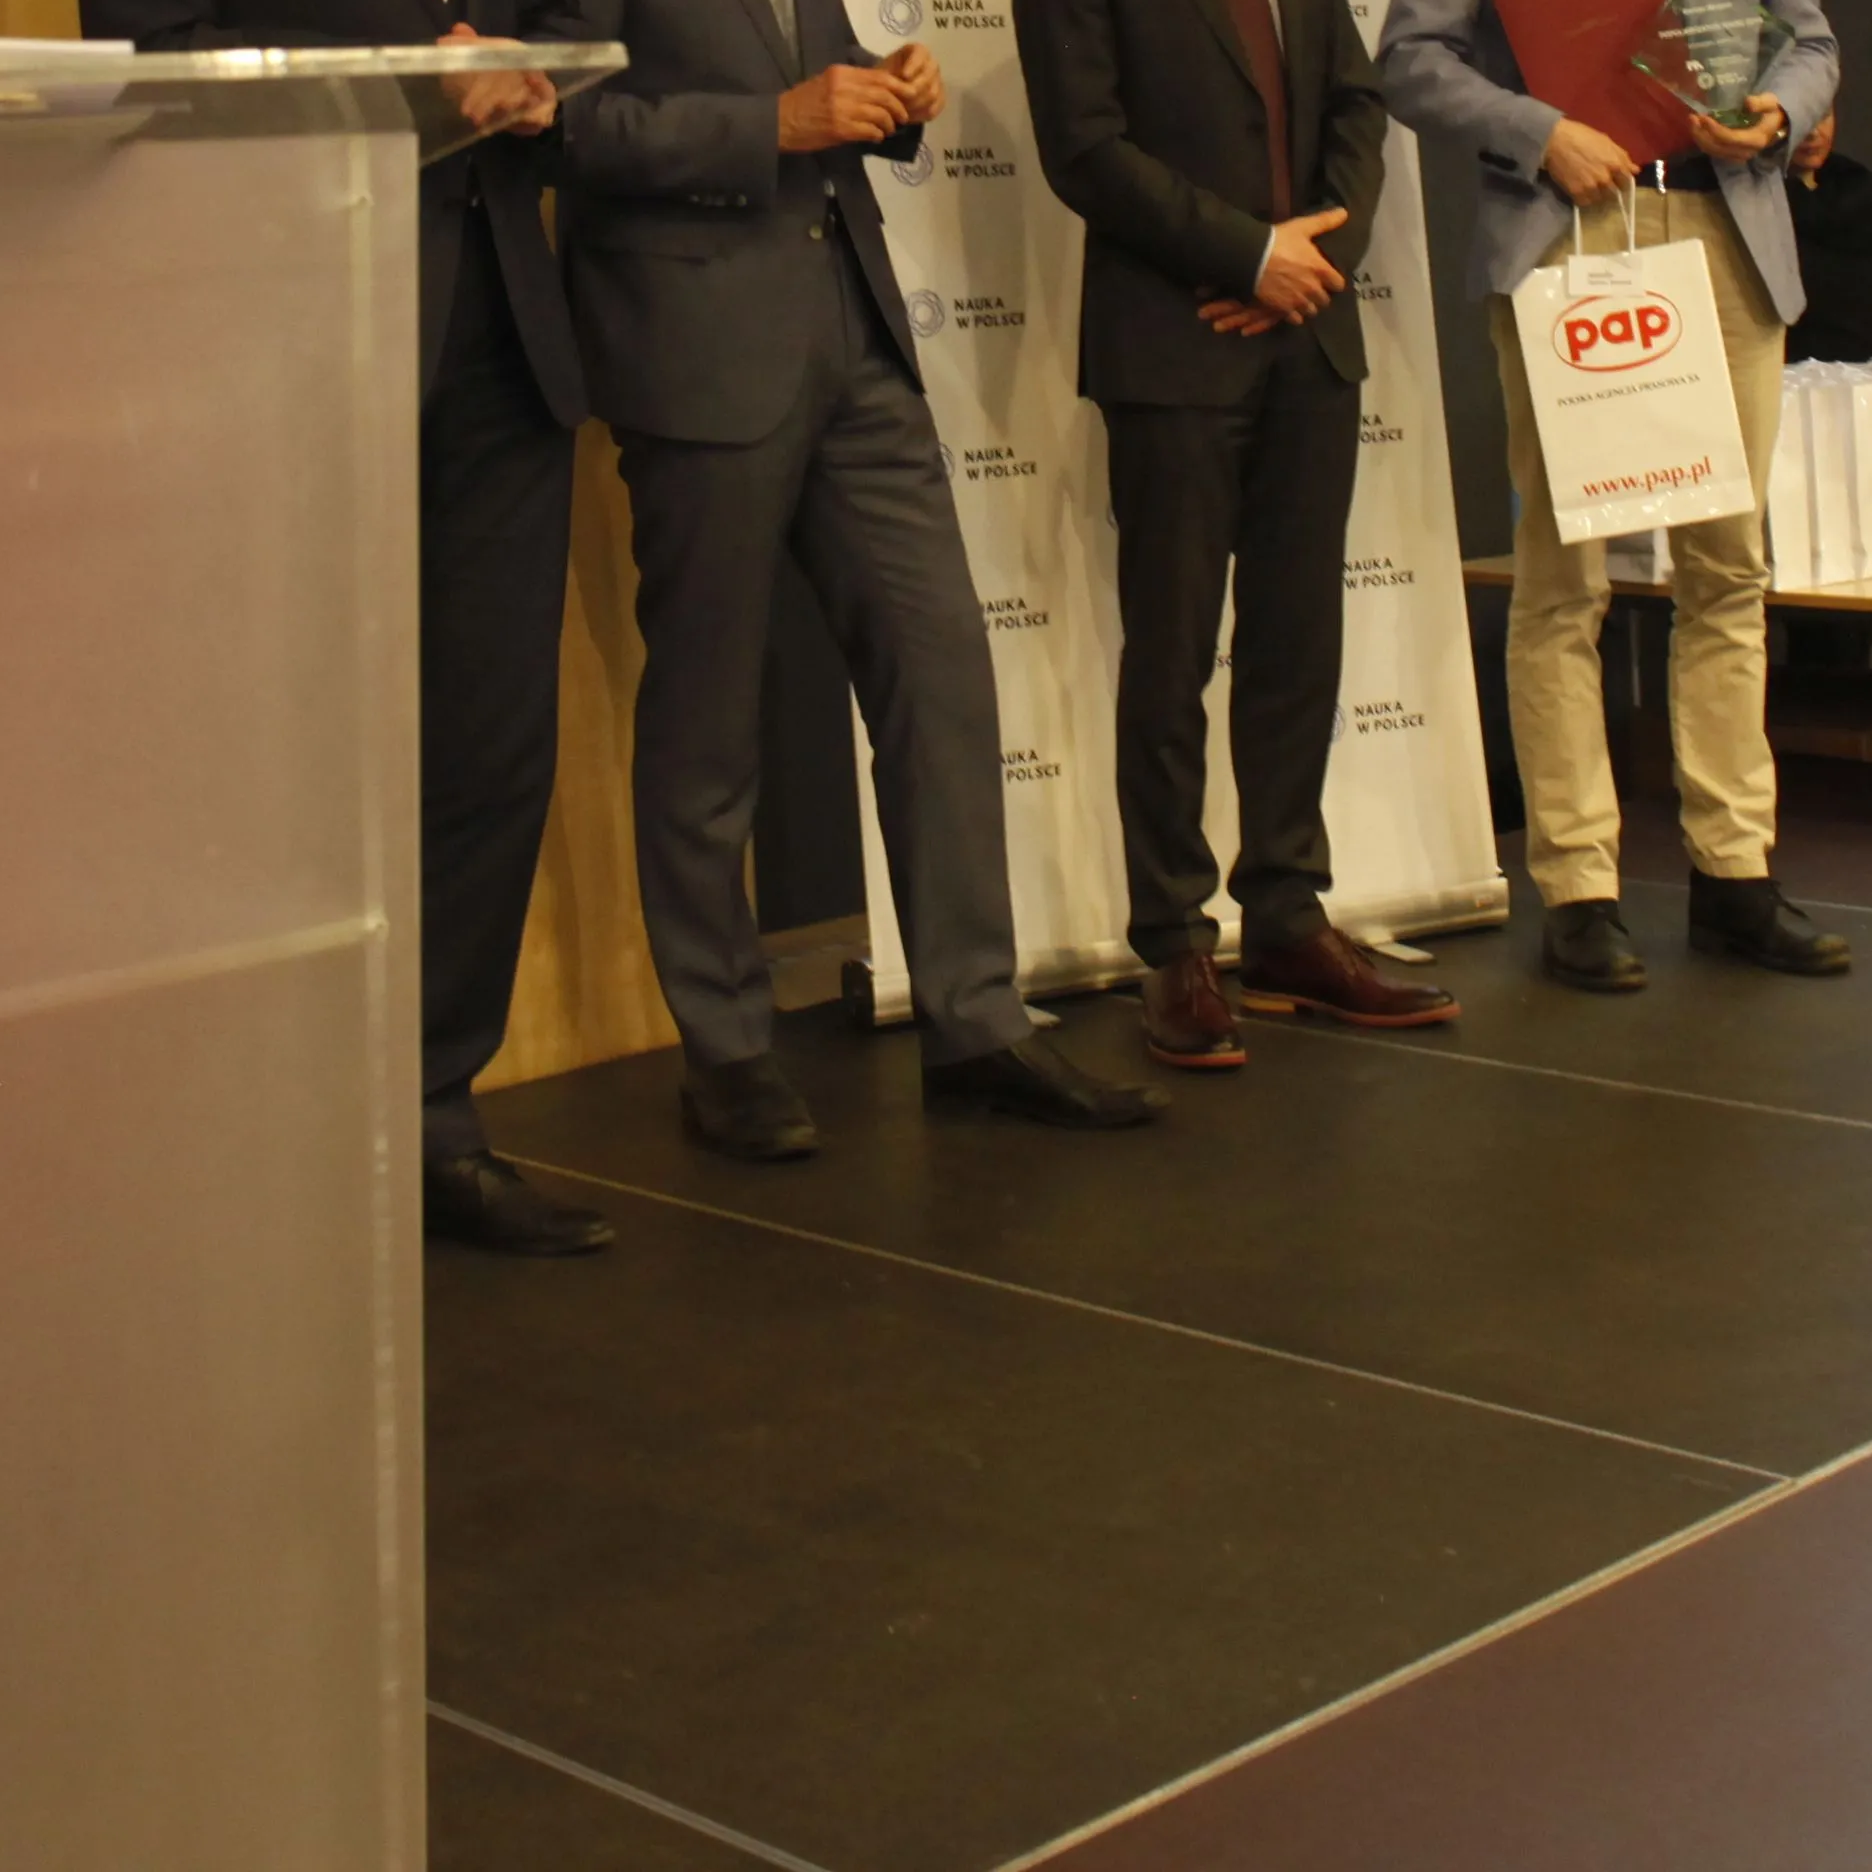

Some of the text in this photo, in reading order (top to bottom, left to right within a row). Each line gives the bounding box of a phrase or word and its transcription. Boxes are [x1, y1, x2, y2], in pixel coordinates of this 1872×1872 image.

[934, 15, 1006, 29] W POLSCE
[944, 148, 995, 161] NAUKA
[945, 163, 1016, 179] W POLSCE
[954, 297, 1005, 312] NAUKA
[956, 312, 1026, 329] W POLSCE
[1563, 304, 1671, 364] pap
[1360, 428, 1404, 444] OLSCE
[964, 446, 1015, 463] NAUKA
[966, 461, 1037, 480] W POLSCE
[1582, 456, 1713, 497] www.pap.pl
[1344, 571, 1415, 590] W POLSCE
[985, 597, 1028, 614] AUKA
[995, 612, 1050, 630] POLSCE
[1353, 700, 1404, 718] NAUKA
[1356, 713, 1426, 735] W POLSCE
[1006, 762, 1061, 784] POLSCE
